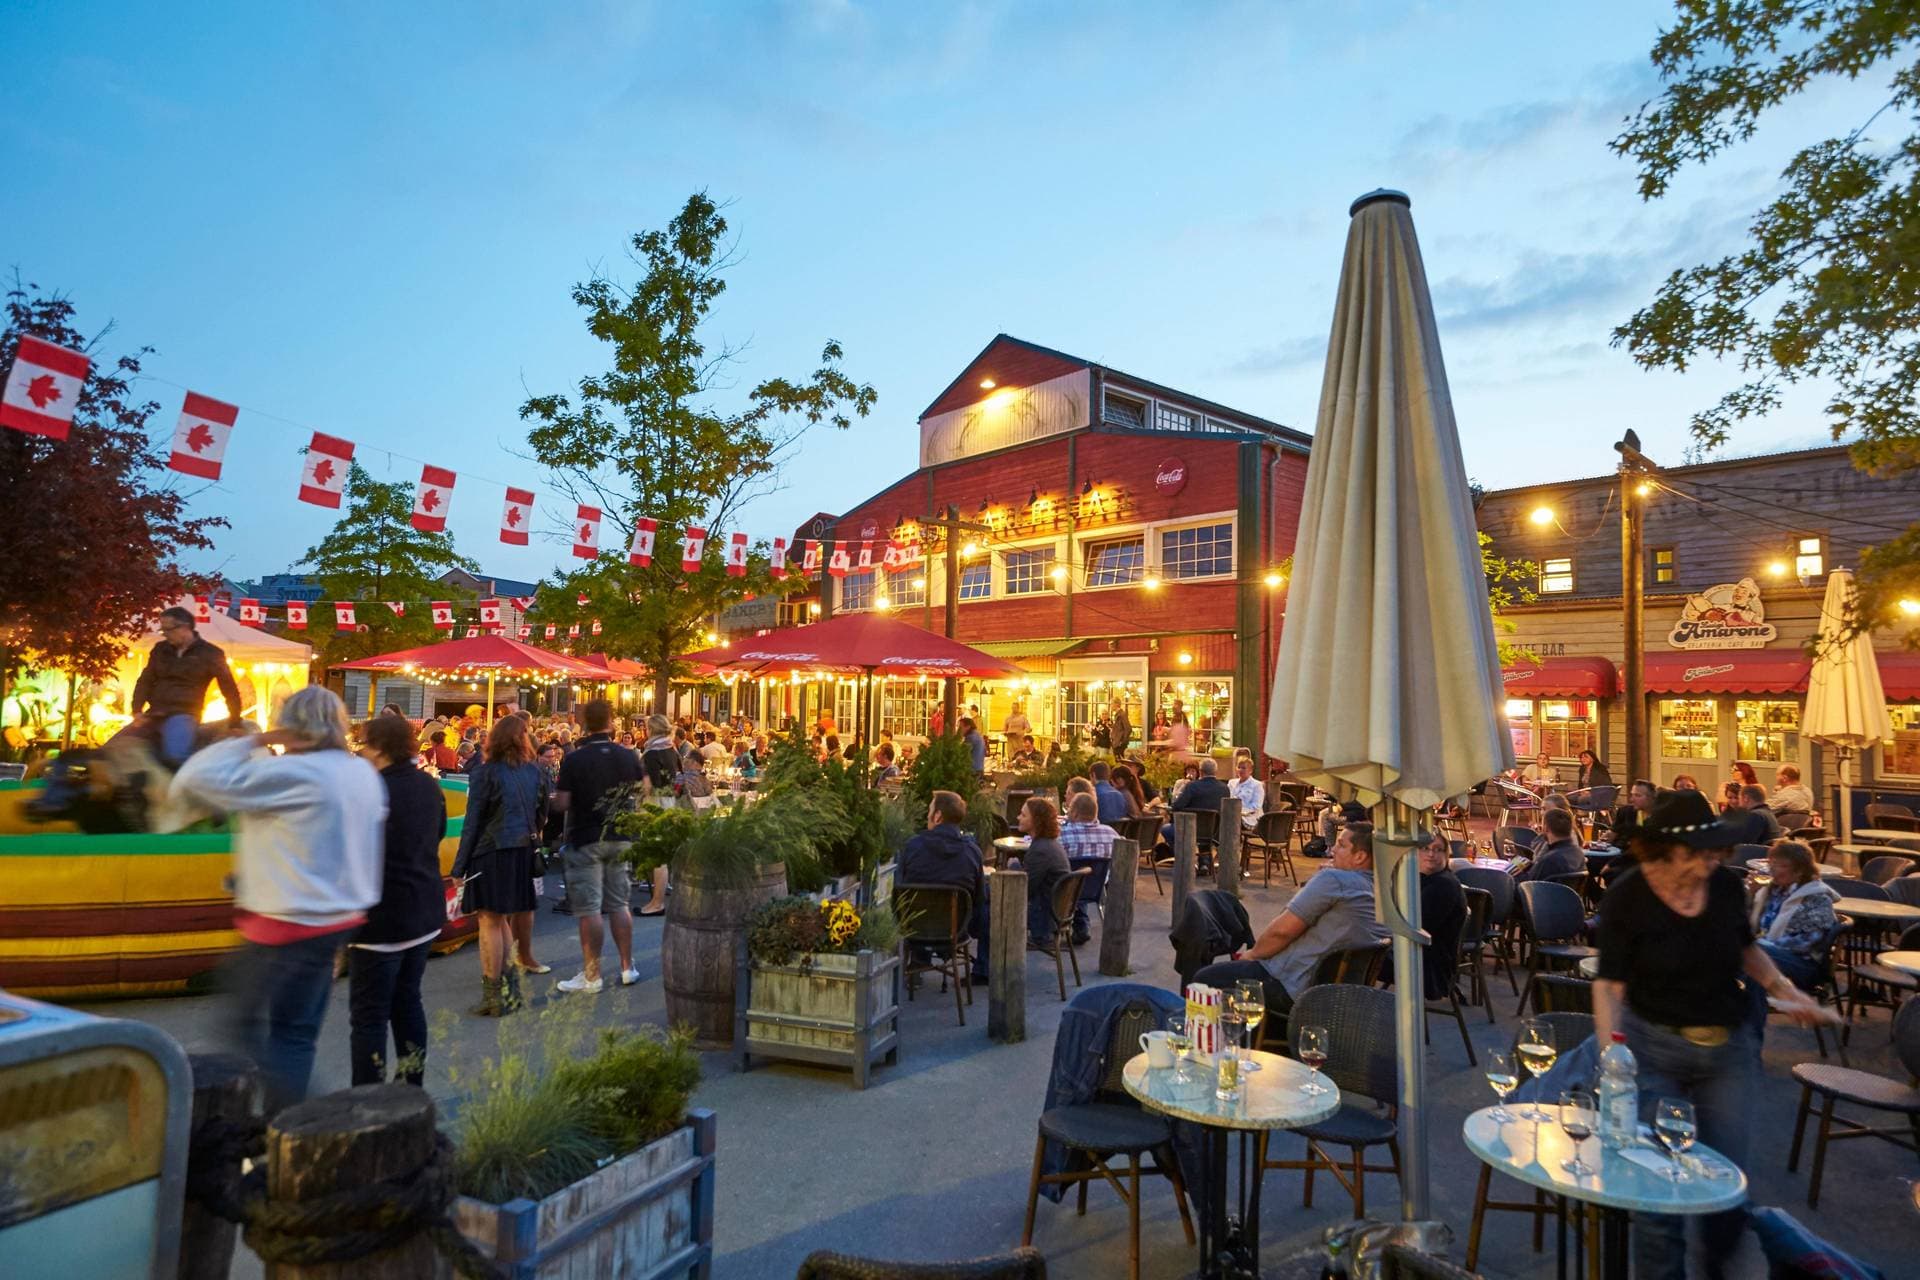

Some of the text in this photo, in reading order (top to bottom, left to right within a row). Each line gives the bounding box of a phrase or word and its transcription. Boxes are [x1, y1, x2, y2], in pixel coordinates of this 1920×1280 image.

[1157, 468, 1184, 486] Coca-Cola
[1674, 621, 1770, 642] Amarone
[1542, 643, 1565, 656] BAR
